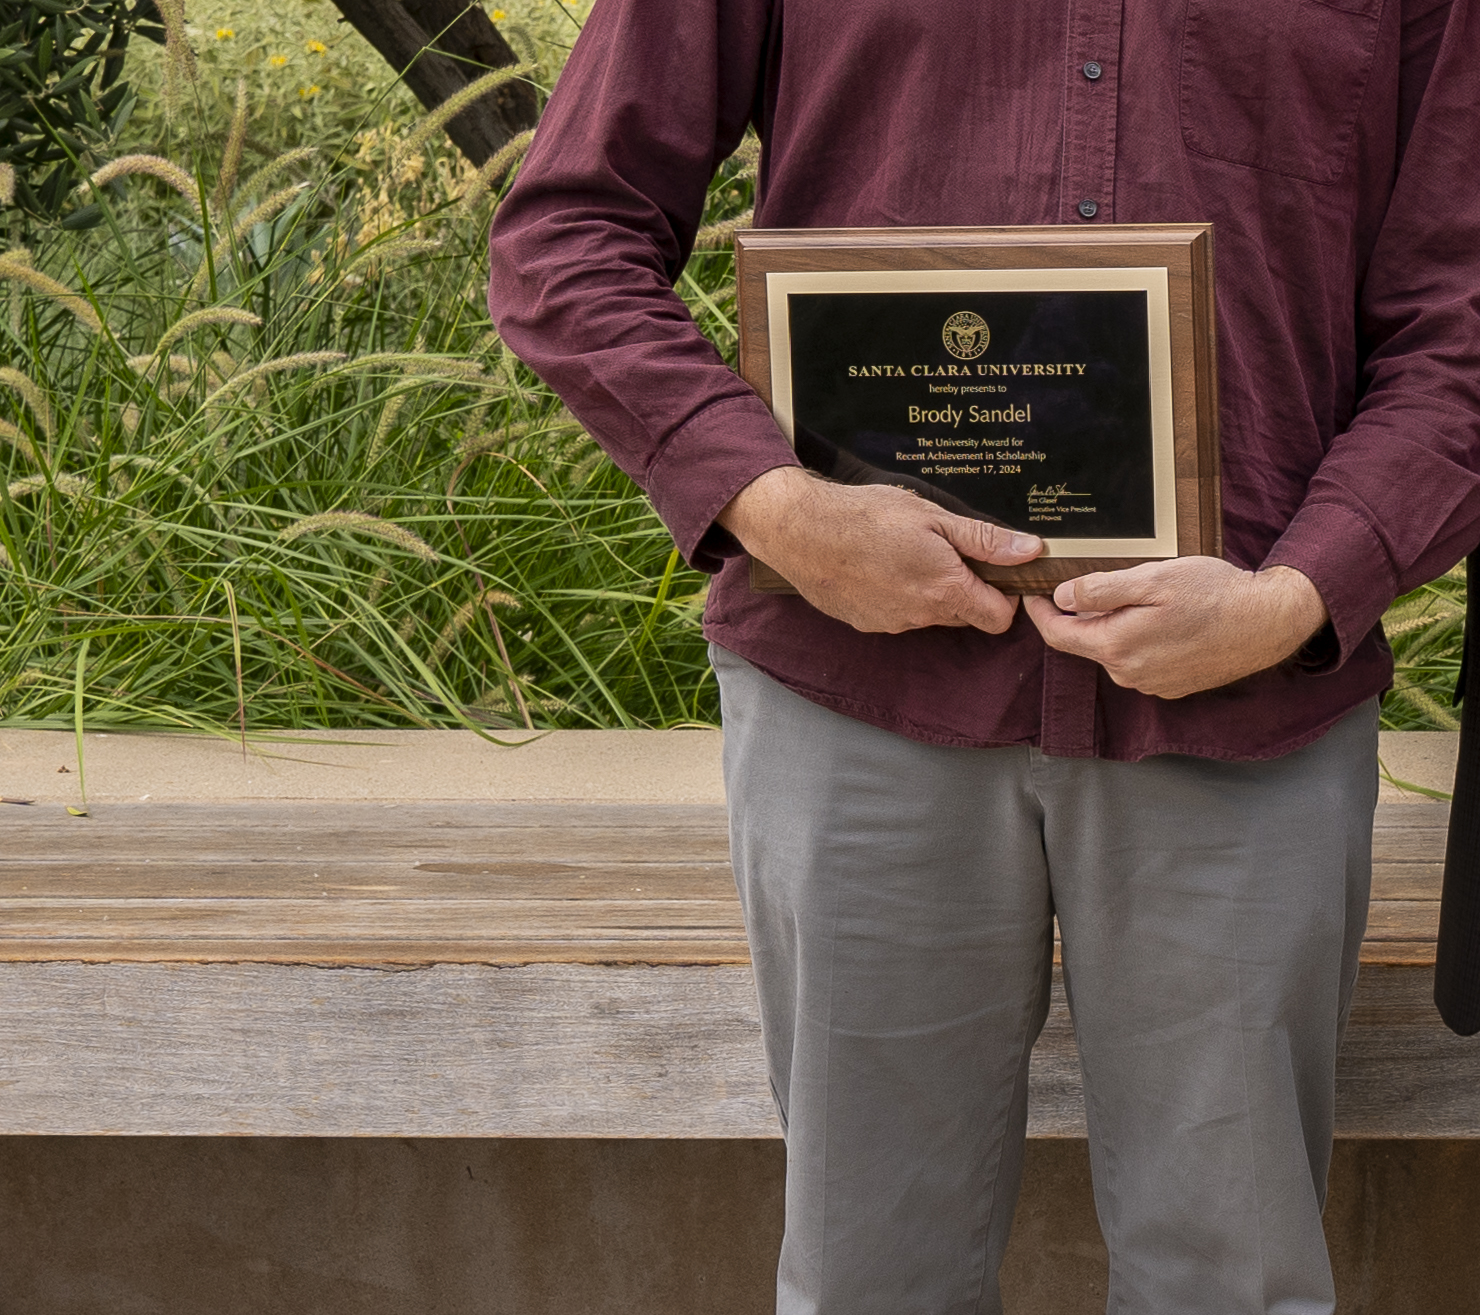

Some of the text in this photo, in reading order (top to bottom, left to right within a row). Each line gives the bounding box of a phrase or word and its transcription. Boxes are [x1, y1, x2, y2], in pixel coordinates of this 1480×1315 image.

[848, 364, 1087, 377] SANTA CLARA UNIVERSITY
[929, 384, 1007, 395] hereby presents to
[908, 403, 1031, 427] Brody Sandel
[917, 437, 1024, 449] The University Award for
[895, 450, 1047, 462] Recent Achievement in Scholarship
[921, 464, 1022, 476] on September 17, 2024
